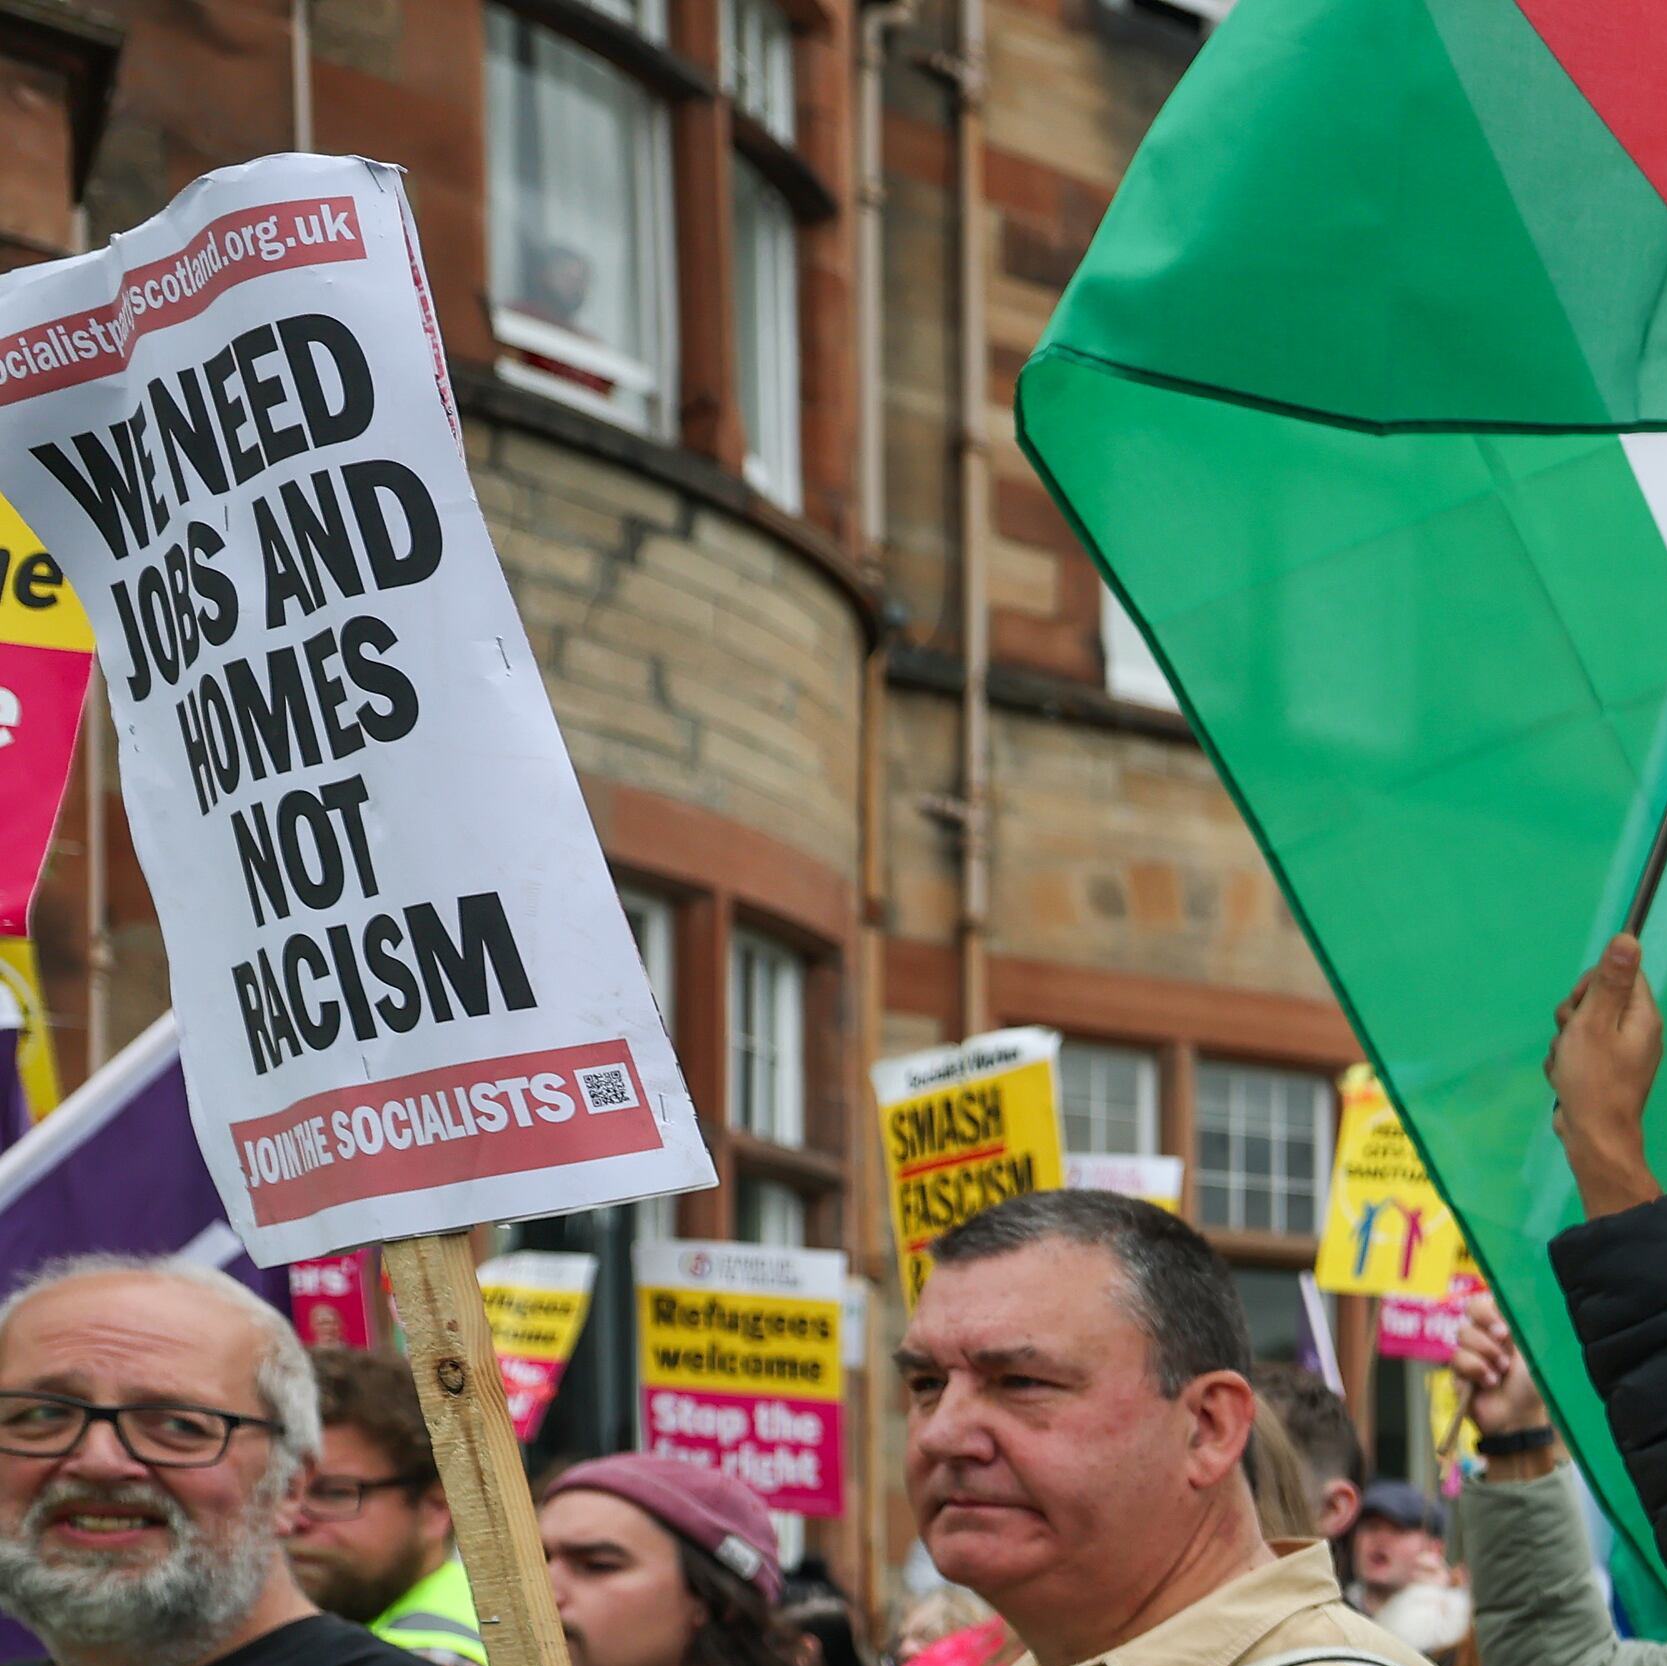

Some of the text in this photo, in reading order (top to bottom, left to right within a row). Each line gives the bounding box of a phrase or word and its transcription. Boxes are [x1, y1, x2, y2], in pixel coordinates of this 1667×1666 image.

[29, 313, 374, 559] WE NEED
[110, 460, 442, 702] JOBS AND
[176, 615, 419, 816] HOMES
[230, 774, 379, 928] NOT
[231, 891, 538, 1075] RACISM
[244, 1073, 576, 1187] JOIN THE SOCIALISTS
[890, 1084, 1005, 1163] SMASH
[901, 1152, 1035, 1234] FASCISM
[654, 1294, 829, 1341] Refugees
[655, 1342, 823, 1382] welcome
[652, 1392, 823, 1447] Stop the
